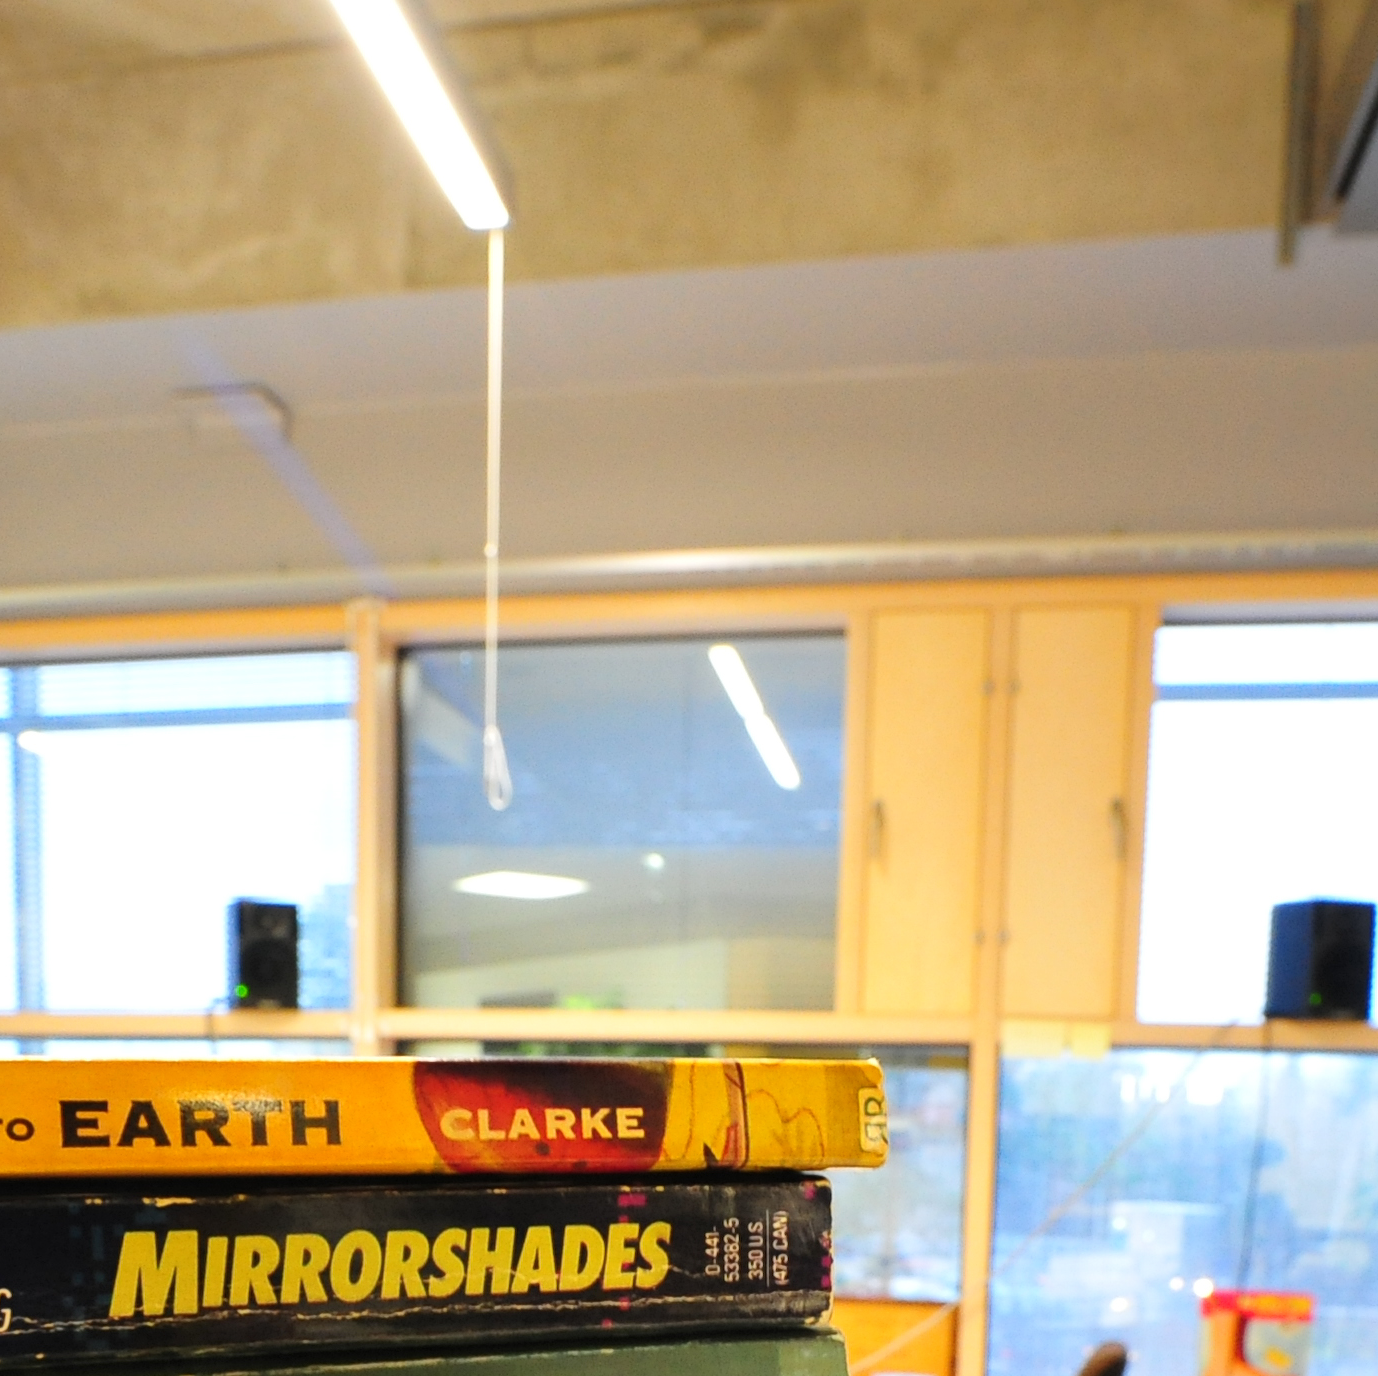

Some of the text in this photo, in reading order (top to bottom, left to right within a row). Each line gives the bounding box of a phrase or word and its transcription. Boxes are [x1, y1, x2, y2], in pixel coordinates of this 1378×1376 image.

[60, 1099, 342, 1149] EARTH
[439, 1106, 645, 1142] CLARKE
[771, 1210, 789, 1251] CAN)
[108, 1221, 673, 1321] MIRRORSHADES
